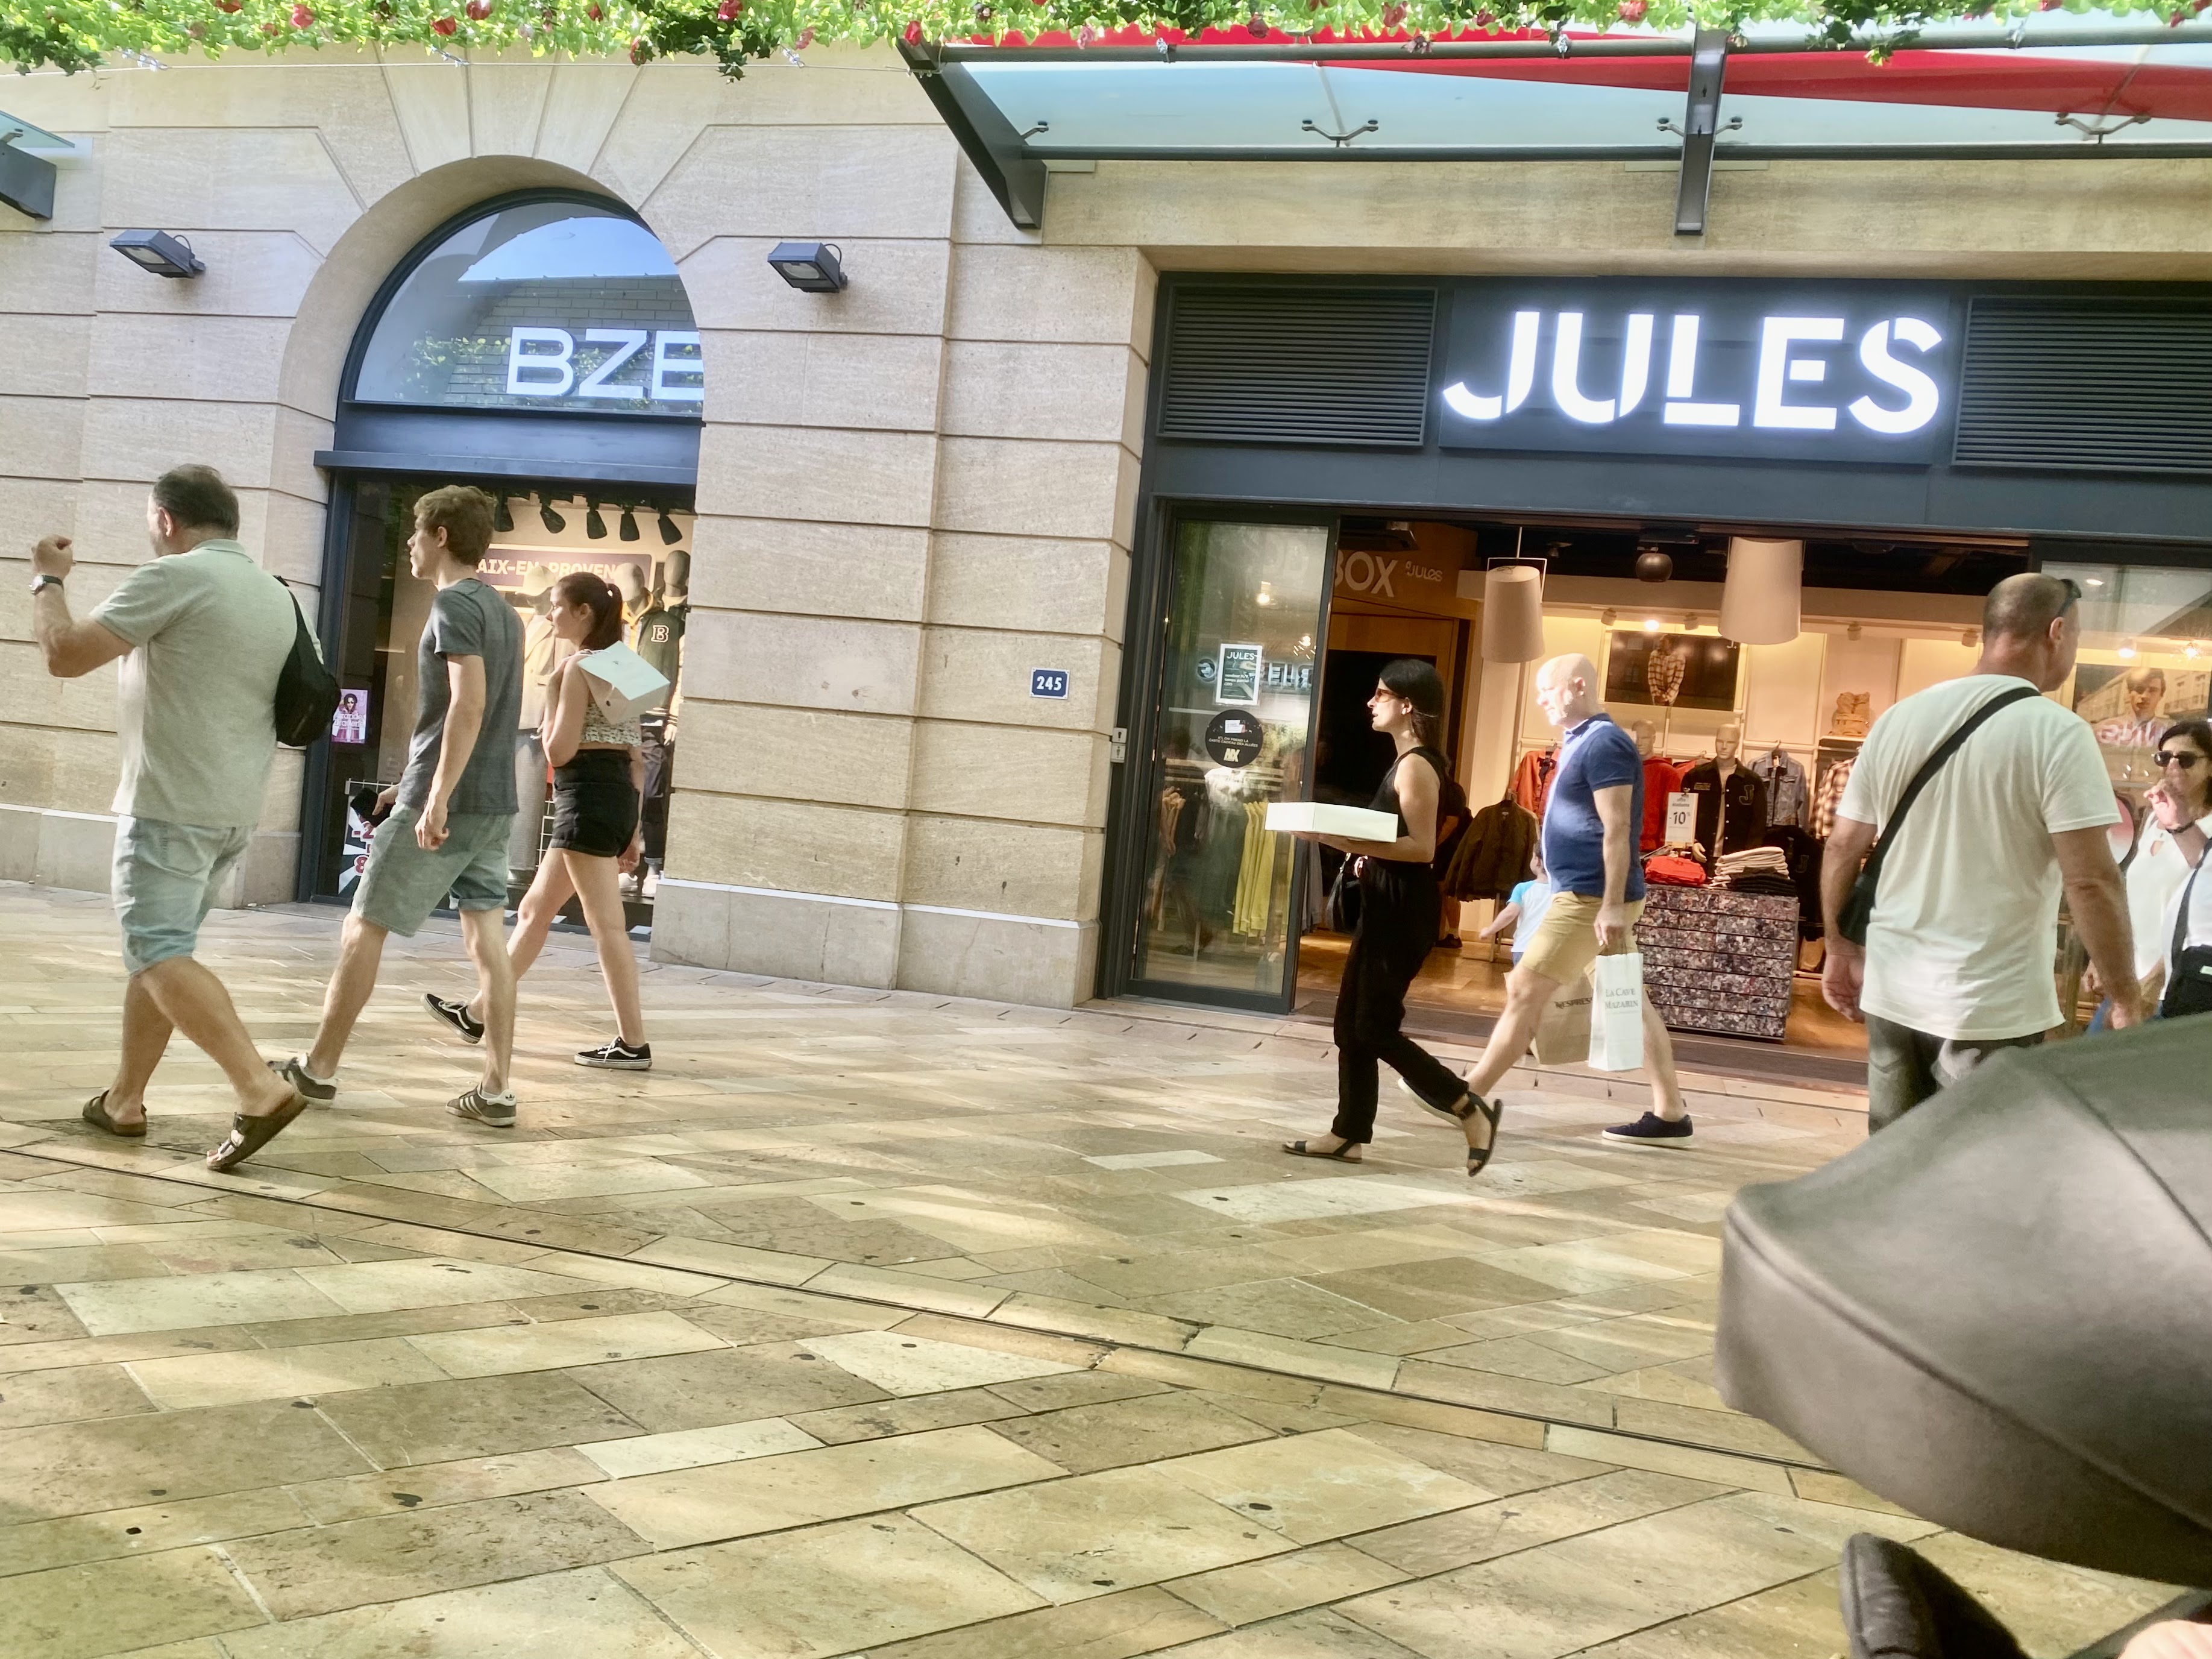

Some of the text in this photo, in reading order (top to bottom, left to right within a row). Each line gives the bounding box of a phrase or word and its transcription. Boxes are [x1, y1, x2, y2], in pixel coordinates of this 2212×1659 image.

[1442, 311, 1943, 433] JULES
[651, 625, 669, 643] B
[1227, 652, 1255, 661] JULES
[1037, 676, 1062, 691] 245
[1739, 784, 1755, 805] J
[1554, 996, 1592, 1009] NESPRES
[1605, 999, 1639, 1009] MAZARIN
